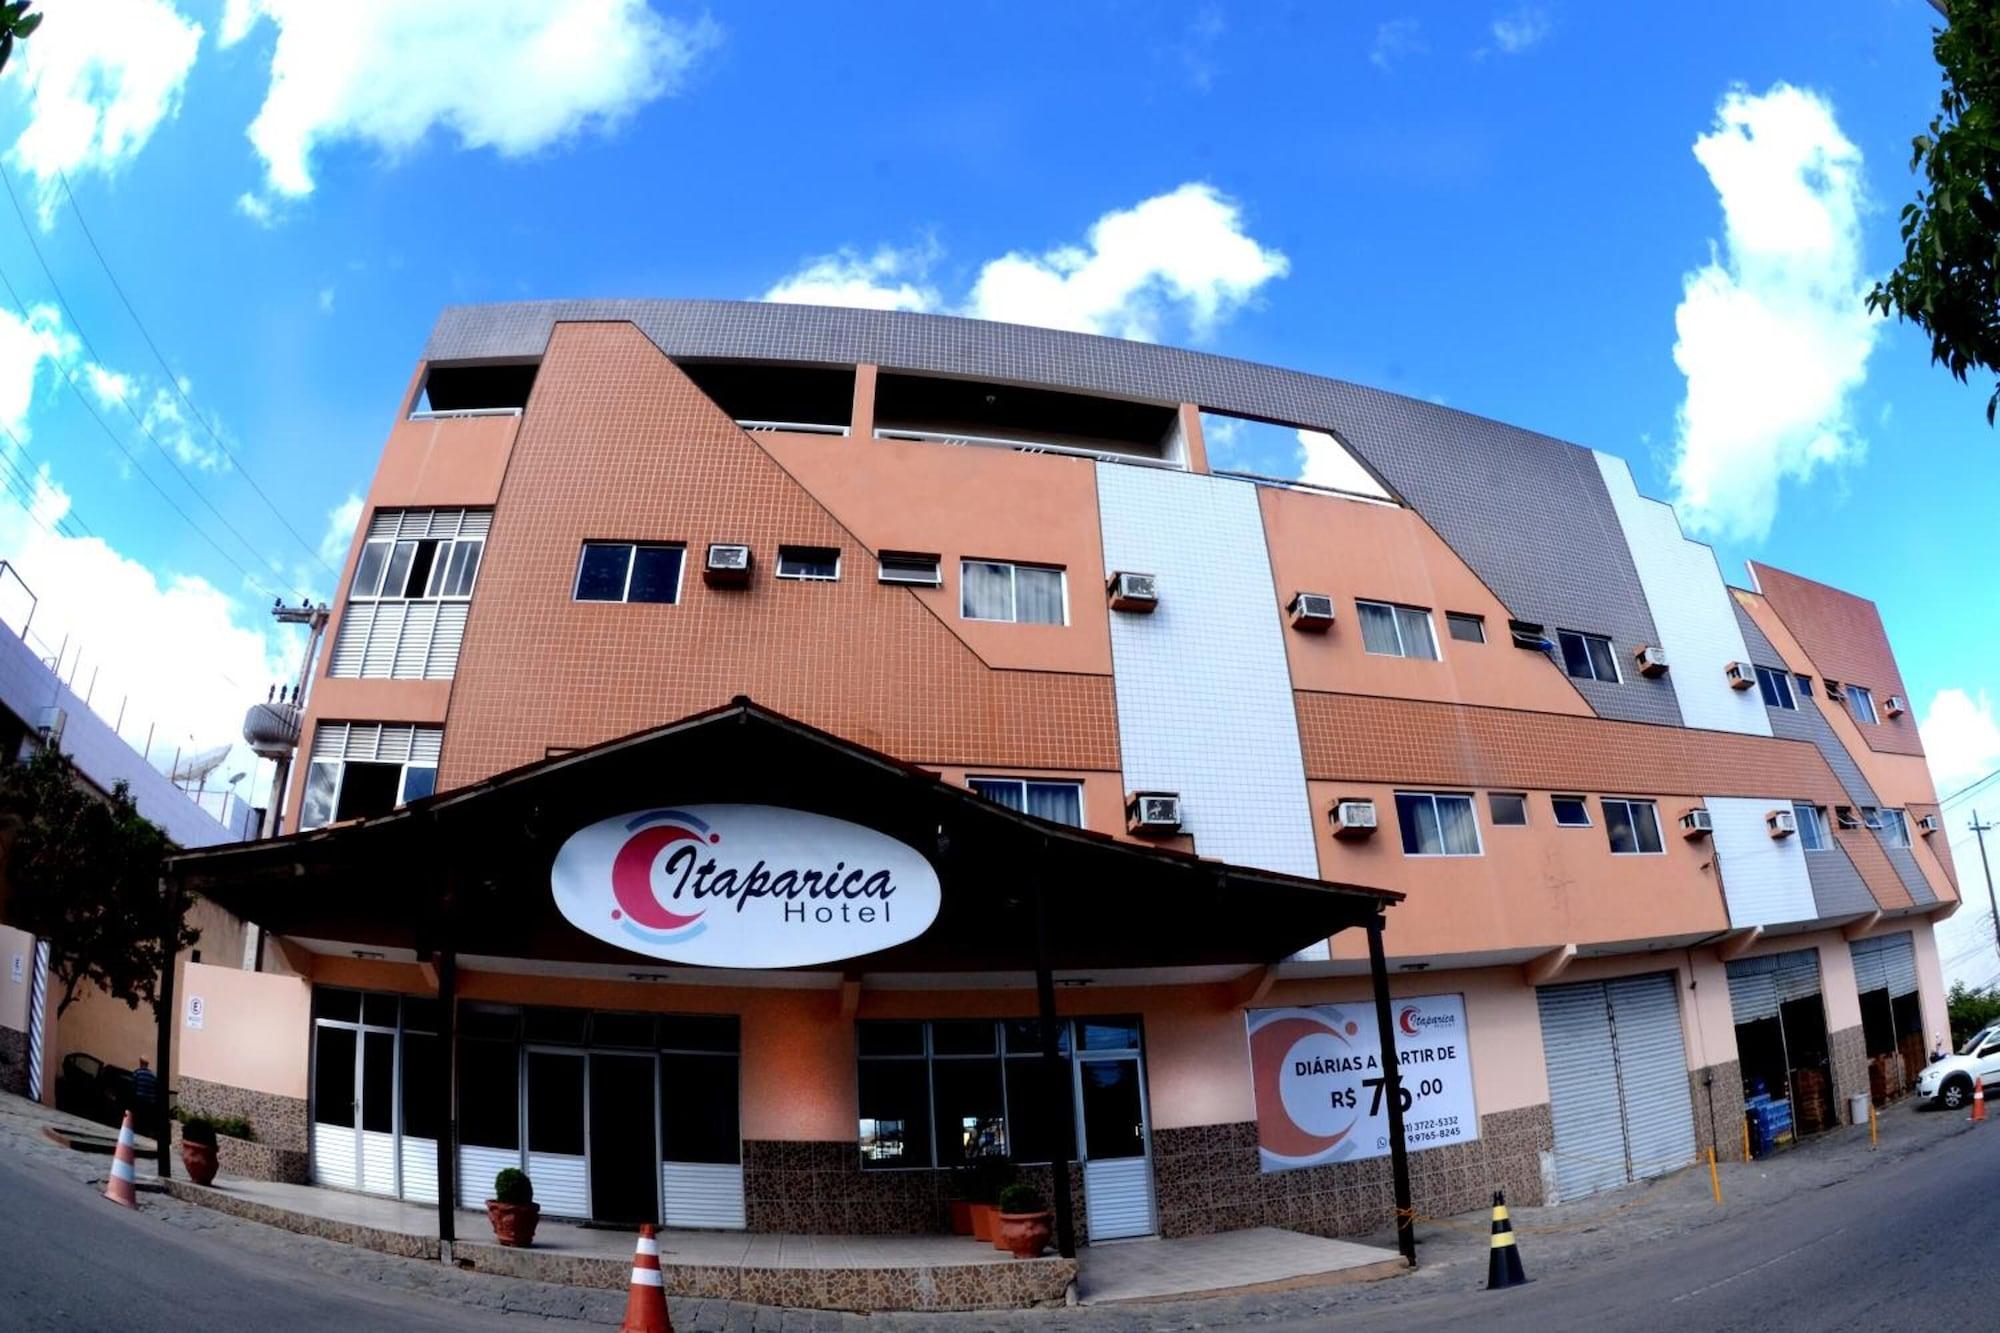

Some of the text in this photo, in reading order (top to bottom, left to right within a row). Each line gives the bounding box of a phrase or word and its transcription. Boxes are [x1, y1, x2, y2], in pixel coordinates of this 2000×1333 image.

[665, 845, 896, 913] Itaparica
[785, 901, 891, 923] Hotel
[1295, 1046, 1456, 1076] DIÁRIAS A RTIR DE
[1331, 1087, 1357, 1109] R$
